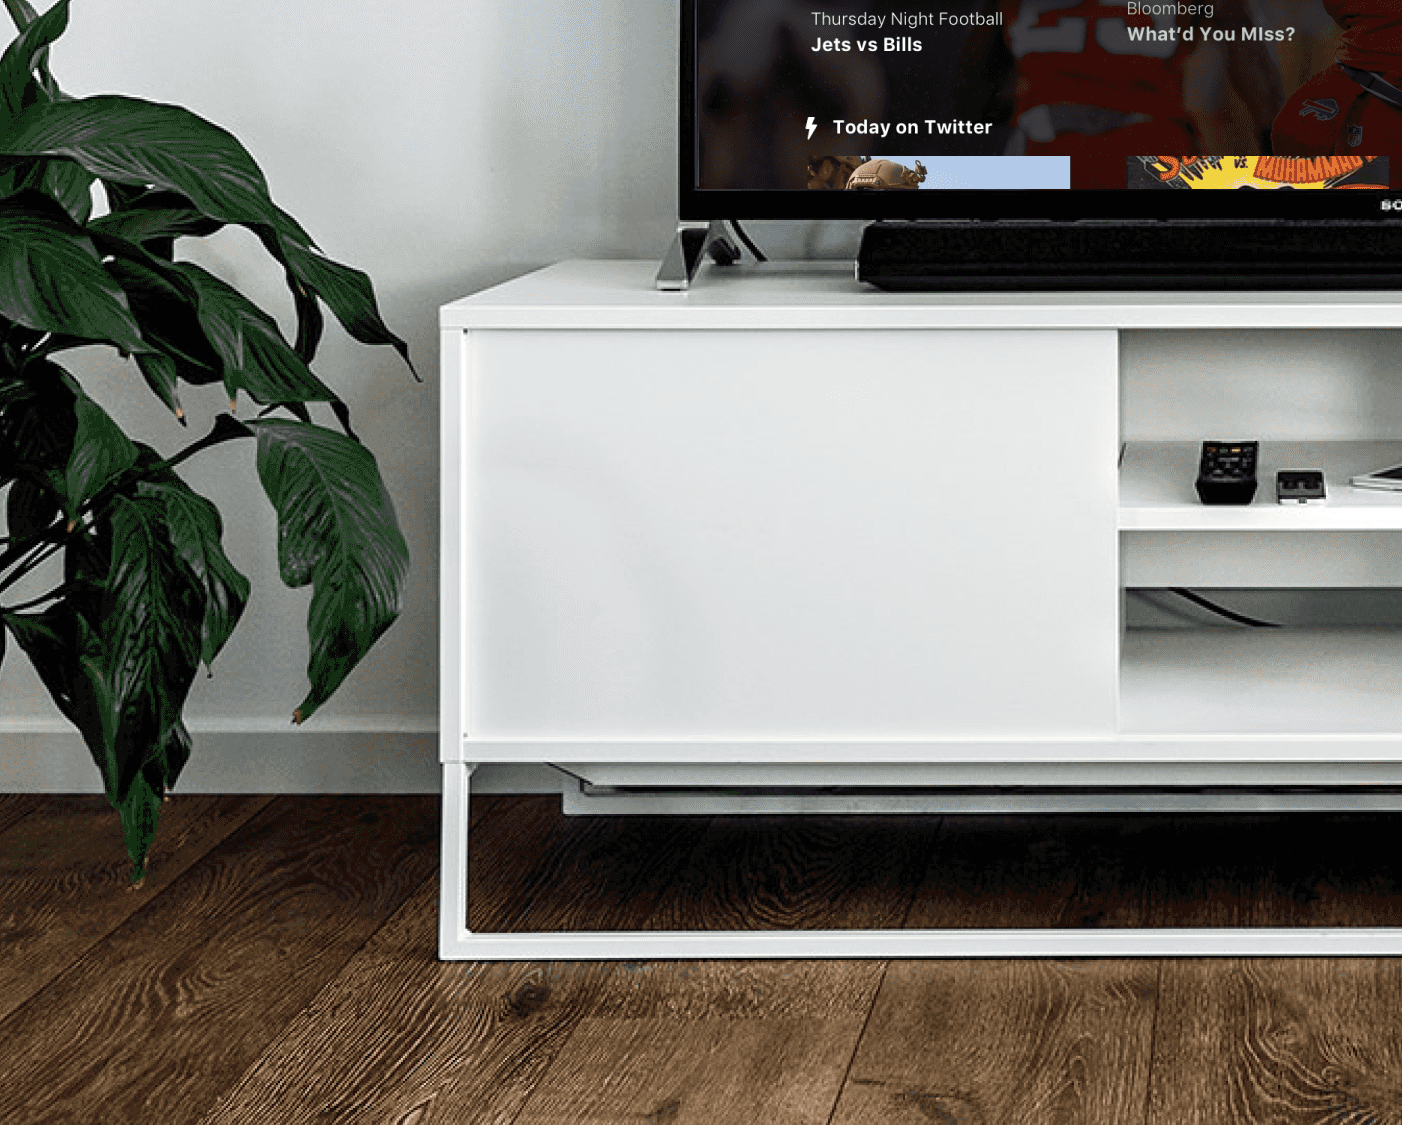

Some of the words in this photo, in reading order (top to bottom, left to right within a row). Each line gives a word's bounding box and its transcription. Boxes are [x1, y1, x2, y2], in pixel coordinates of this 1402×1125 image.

[1127, 1, 1214, 18] Bloomberg
[811, 11, 886, 29] Thursday
[891, 11, 934, 29] Night
[939, 11, 1003, 26] Football
[1200, 27, 1235, 42] You
[811, 37, 852, 52] Jets
[857, 40, 878, 52] vs
[883, 36, 923, 52] Bills
[833, 119, 891, 138] Today
[896, 122, 919, 135] on
[925, 119, 993, 135] Twitter
